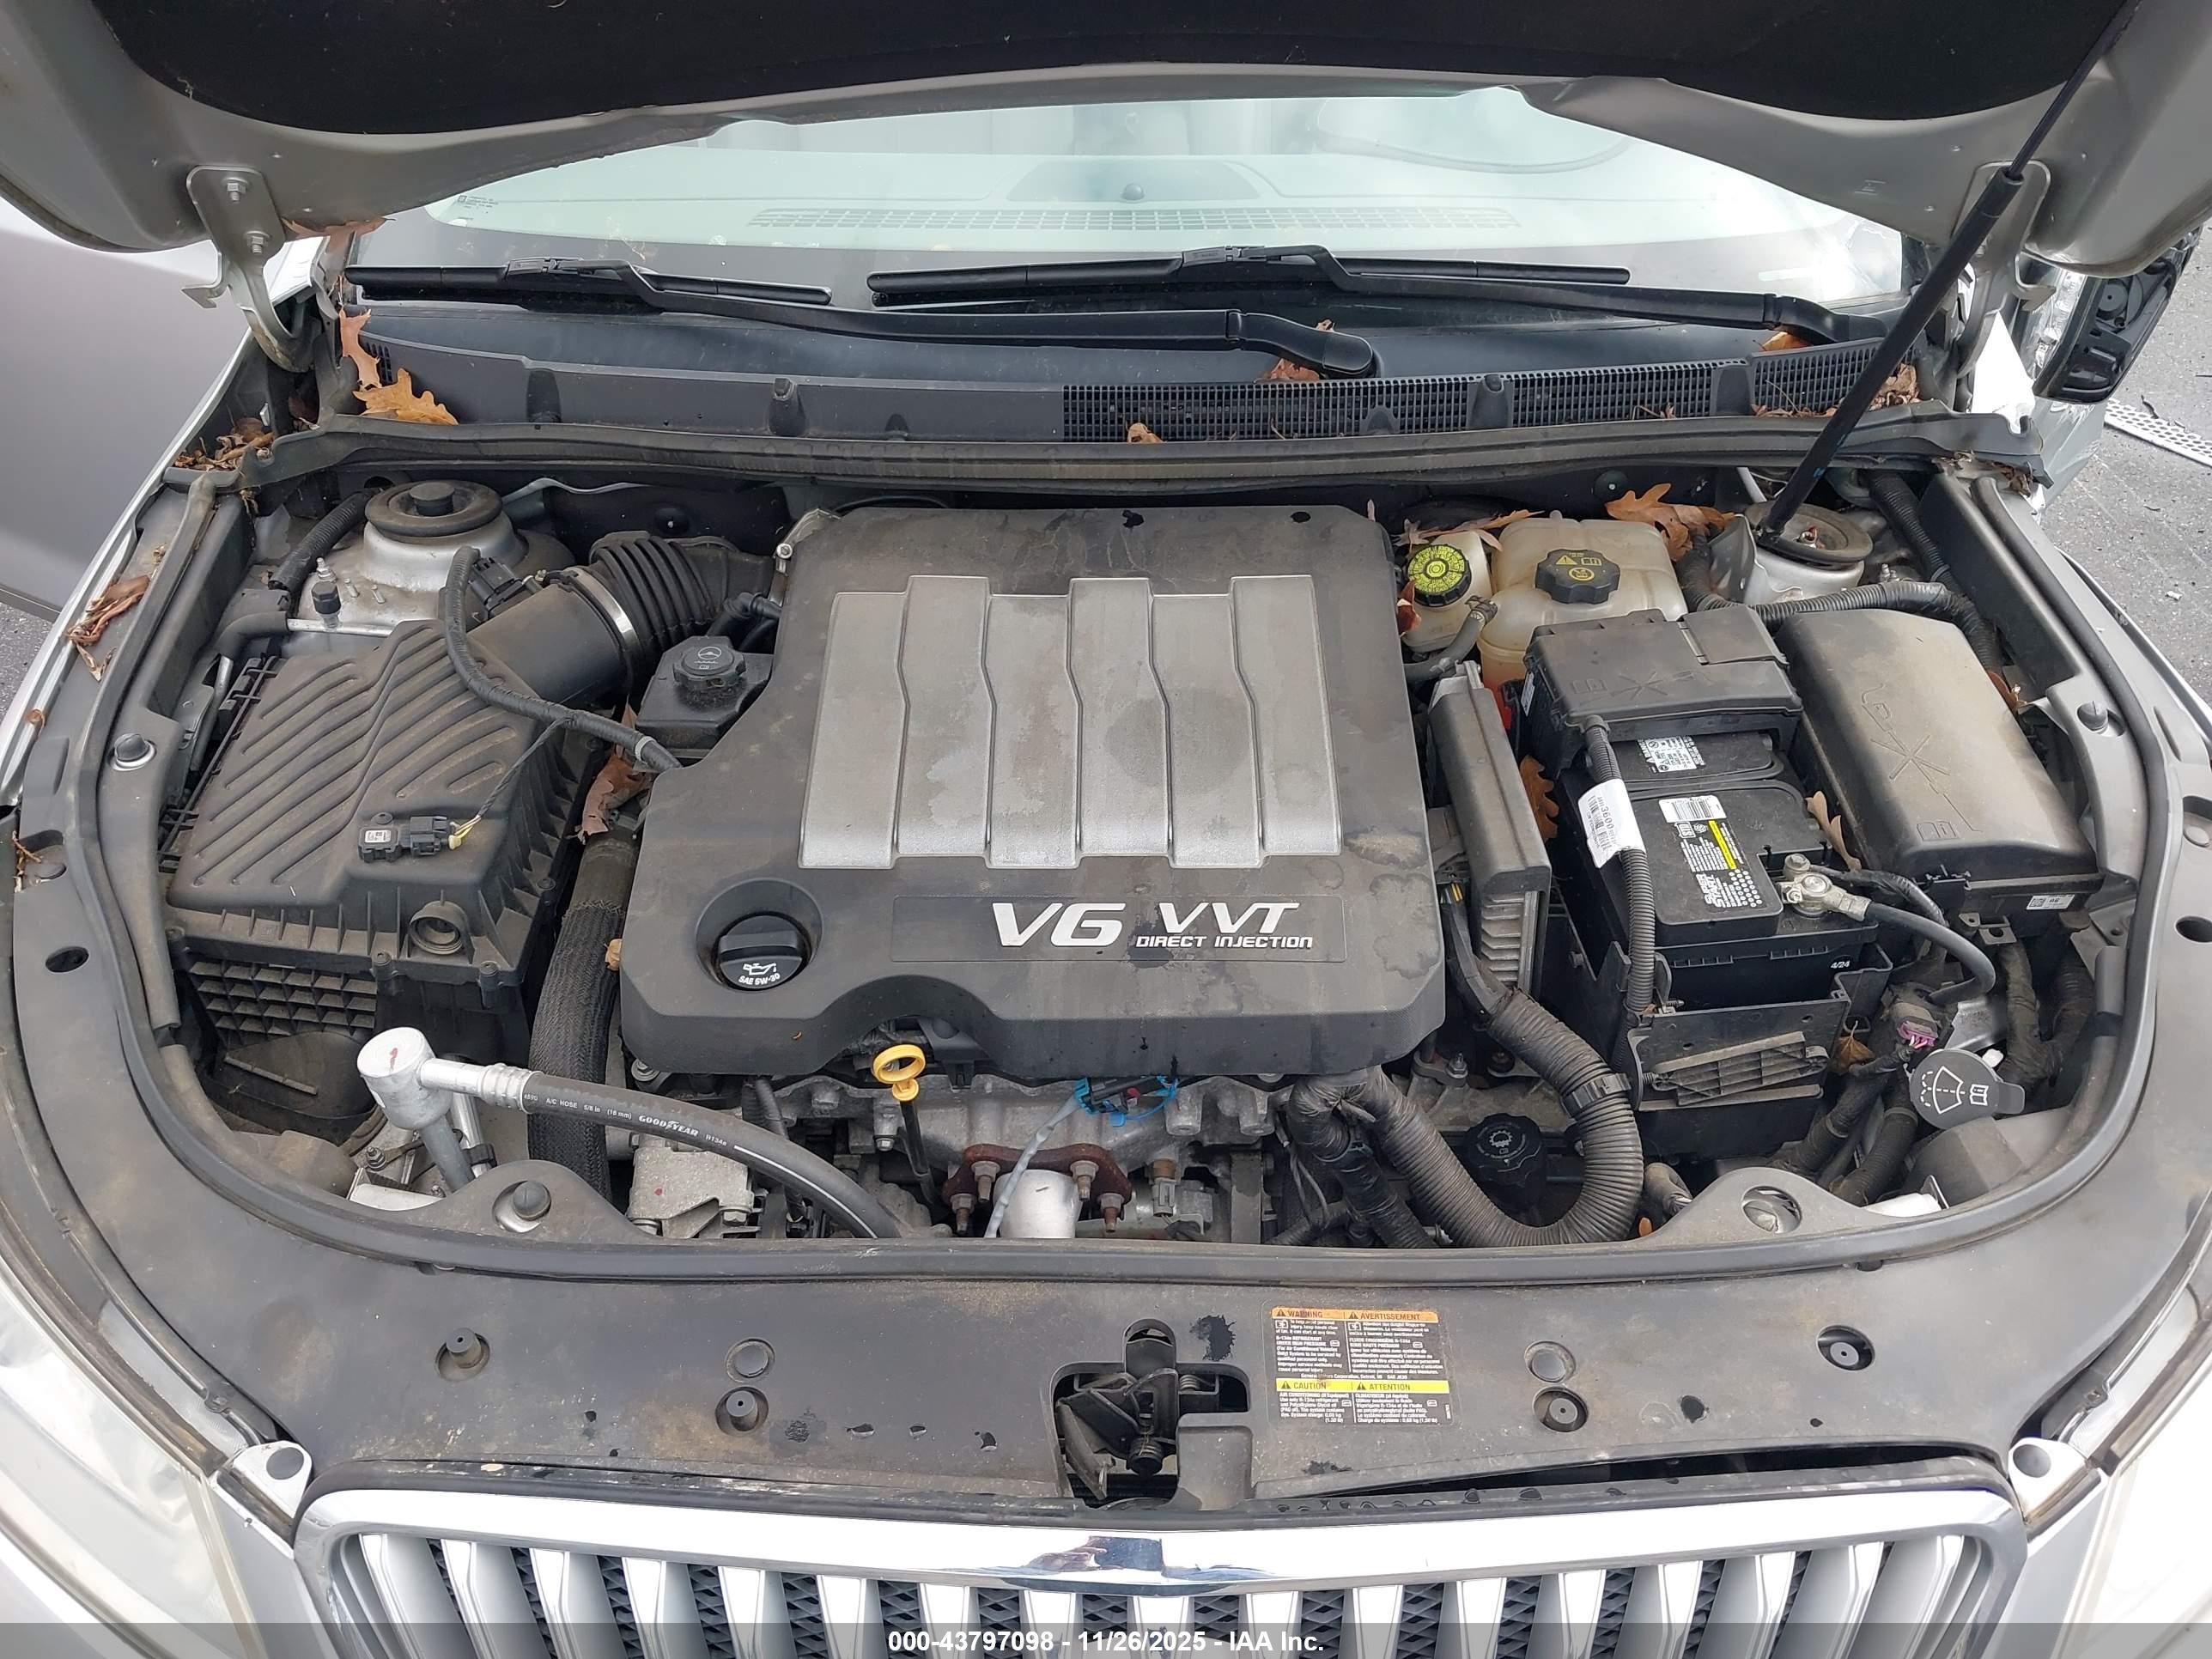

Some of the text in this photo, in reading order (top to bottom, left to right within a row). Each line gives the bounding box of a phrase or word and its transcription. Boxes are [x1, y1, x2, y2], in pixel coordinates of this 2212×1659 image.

[1696, 874, 1713, 904] SUPER
[1705, 874, 1726, 908] START
[992, 902, 1300, 946] V6 VVT
[1136, 935, 1313, 949] DIRECT INJECTION
[1830, 960, 1850, 969] 4/24
[738, 973, 781, 985] SAE 5W-30
[639, 1115, 698, 1137] GOODYEAR
